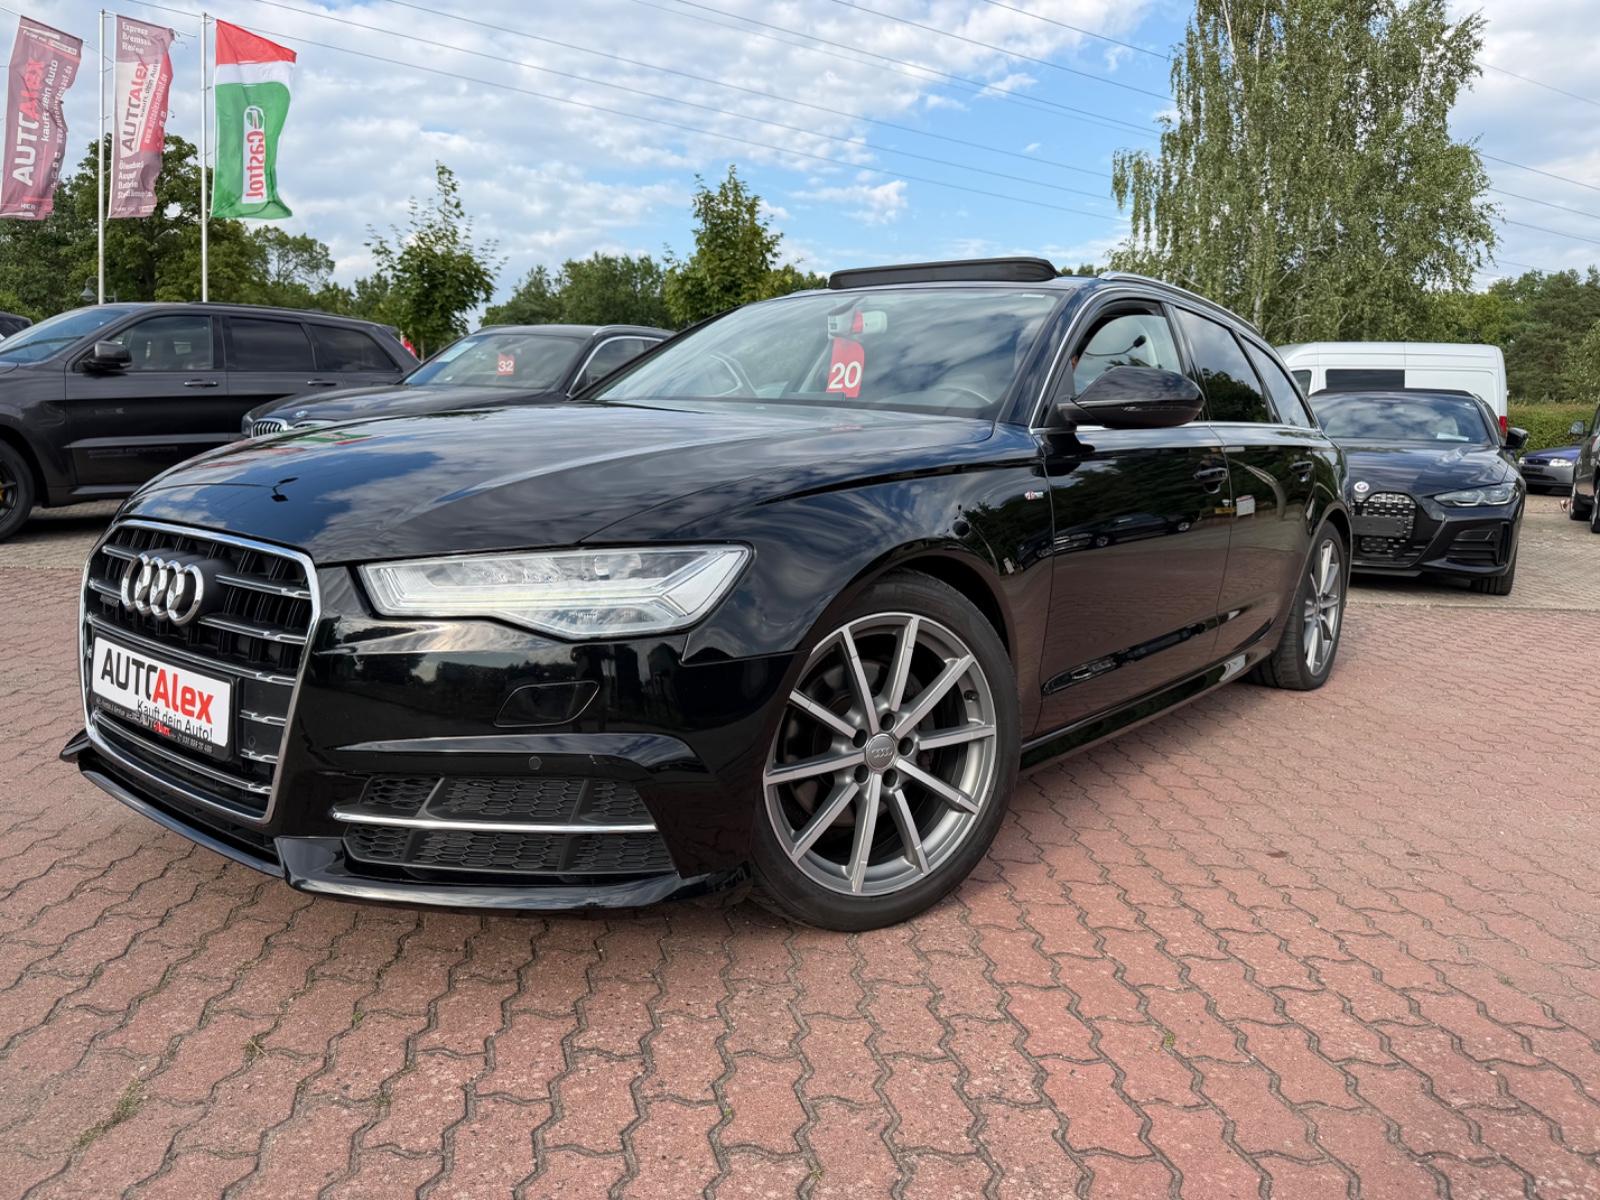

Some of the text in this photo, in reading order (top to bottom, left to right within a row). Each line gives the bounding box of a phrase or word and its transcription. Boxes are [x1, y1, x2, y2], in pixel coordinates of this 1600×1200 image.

[498, 360, 514, 372] 32
[828, 361, 862, 389] 20
[137, 699, 160, 721] Kauft
[162, 710, 182, 730] dein
[185, 720, 213, 742] Auto!
